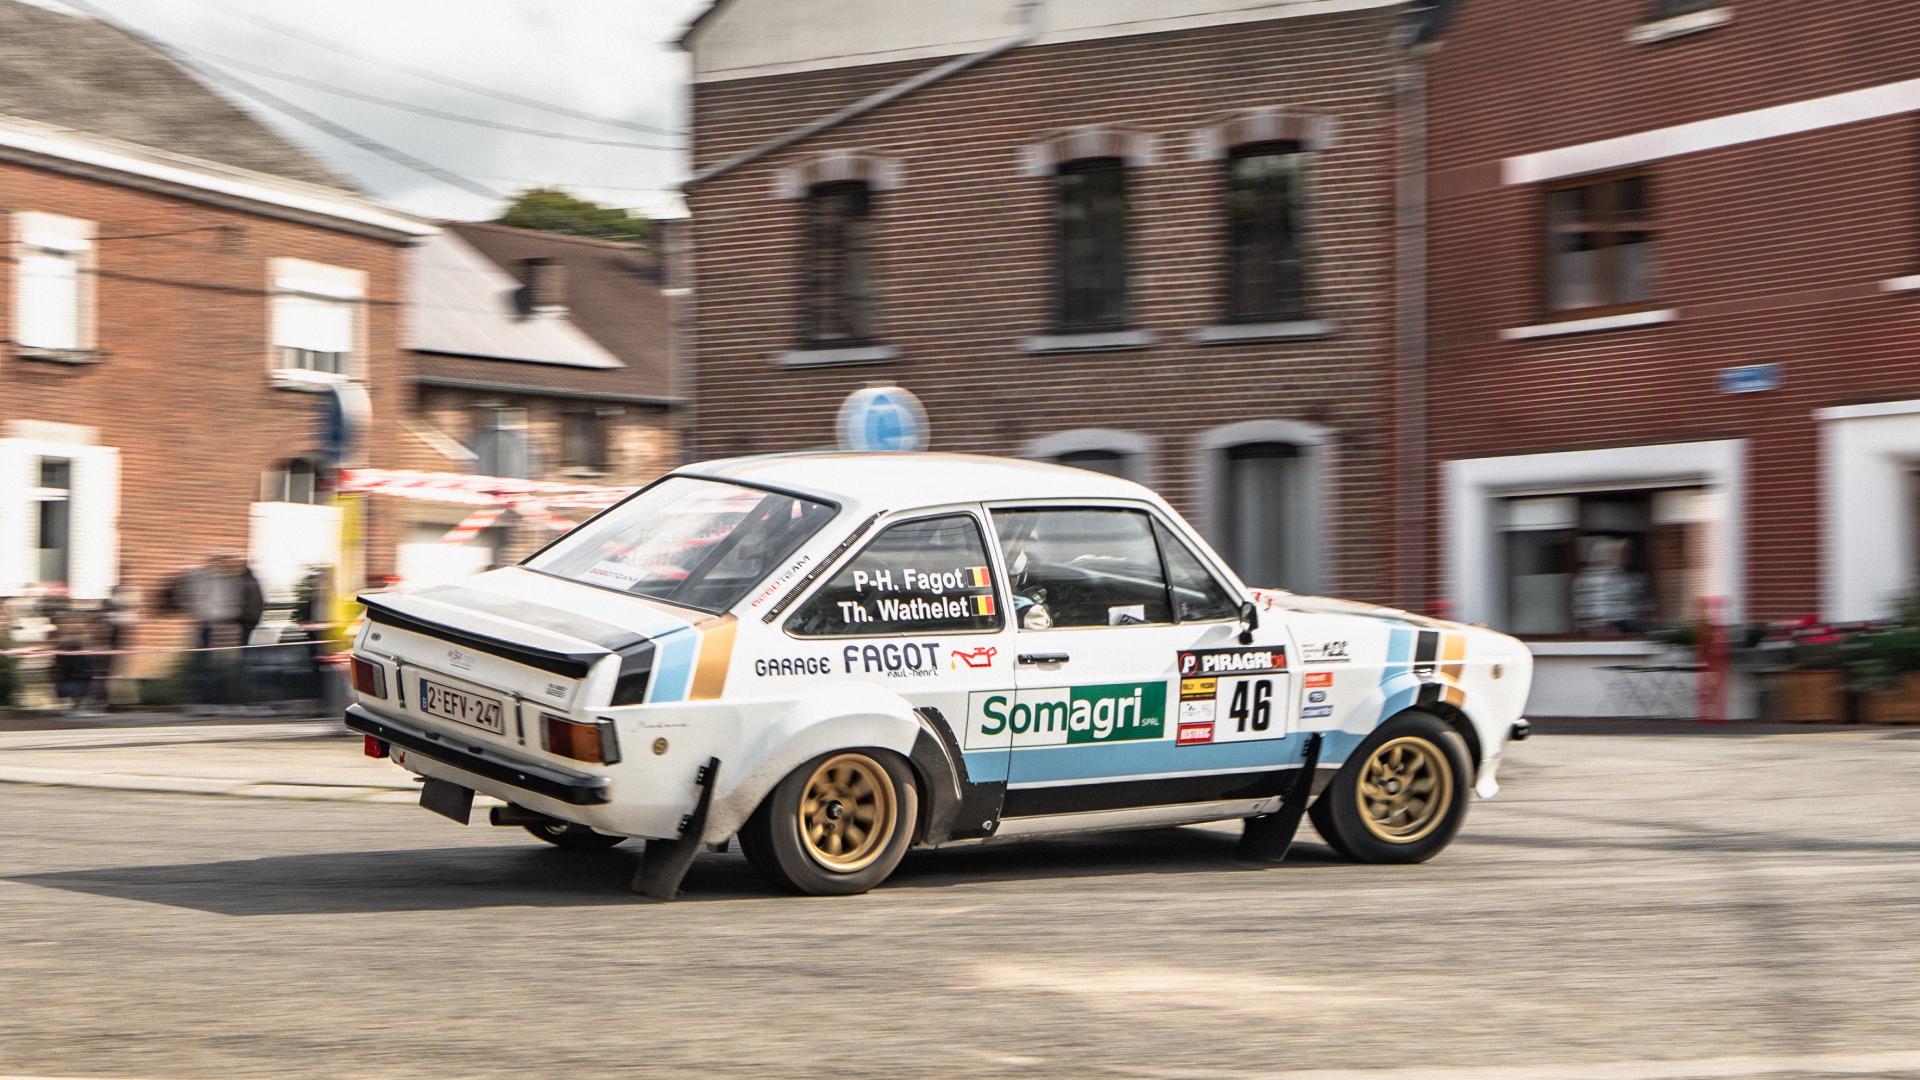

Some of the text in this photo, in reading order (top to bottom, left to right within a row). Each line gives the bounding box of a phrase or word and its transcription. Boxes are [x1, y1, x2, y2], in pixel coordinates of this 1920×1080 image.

[854, 569, 964, 593] P-H. Fagot
[837, 598, 969, 623] Th. Wathelet
[755, 643, 939, 677] GARAGE FAGOT
[1202, 651, 1272, 672] PIRAGRI
[981, 688, 1142, 738] Somagri
[1229, 680, 1272, 732] 46
